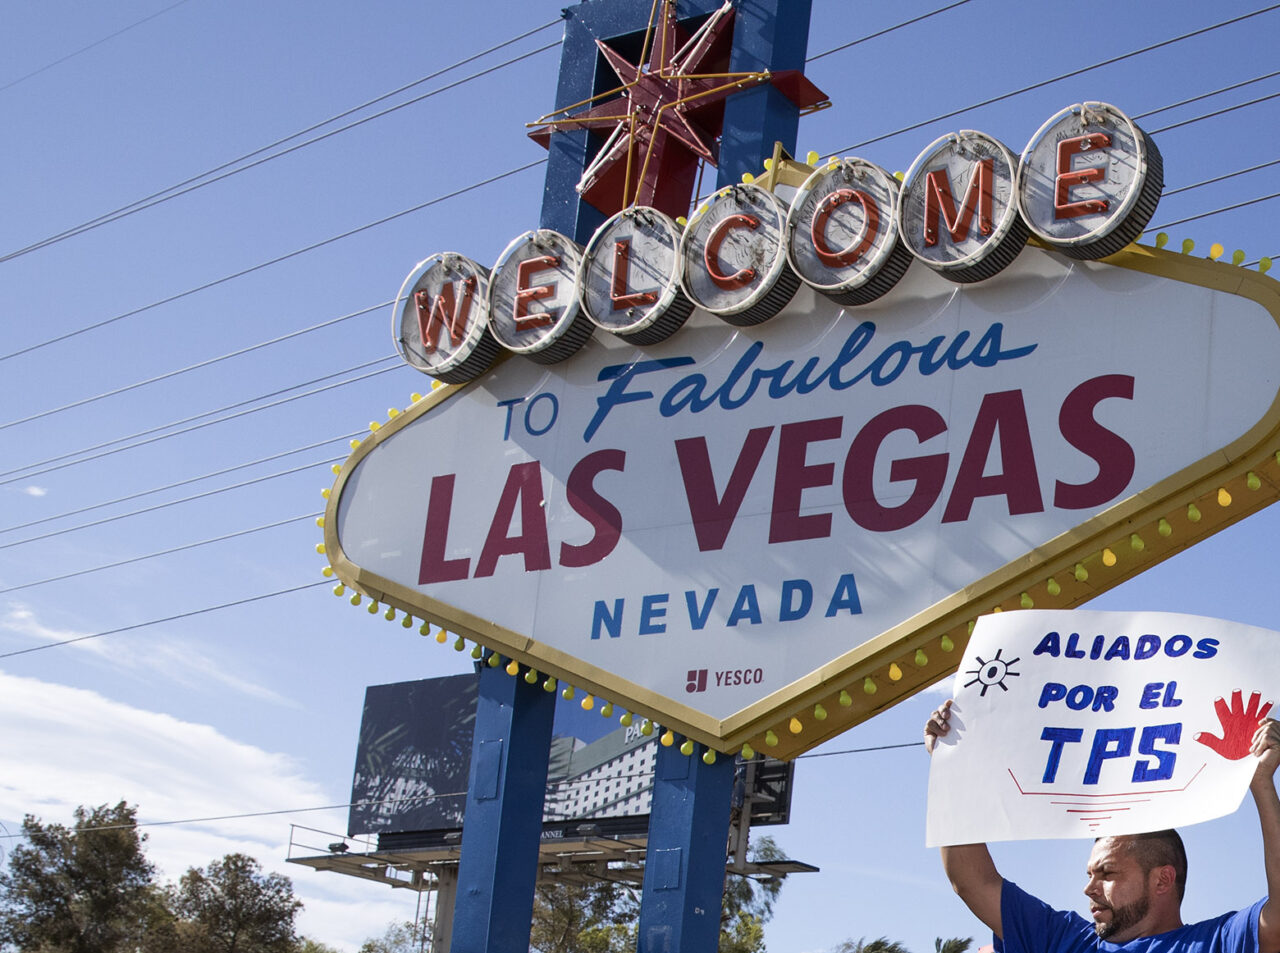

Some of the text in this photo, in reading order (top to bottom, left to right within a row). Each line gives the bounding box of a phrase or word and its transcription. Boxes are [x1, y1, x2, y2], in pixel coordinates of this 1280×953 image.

[412, 130, 1113, 356] WELCOME
[497, 321, 1039, 443] TO Fabulous
[417, 373, 1136, 586] LAS VEGAS
[590, 572, 863, 641] NEVADA
[715, 667, 763, 687] YESCO
[1033, 631, 1221, 661] ALIADOS
[1038, 680, 1183, 712] POR EL
[1039, 722, 1183, 786] TPS
